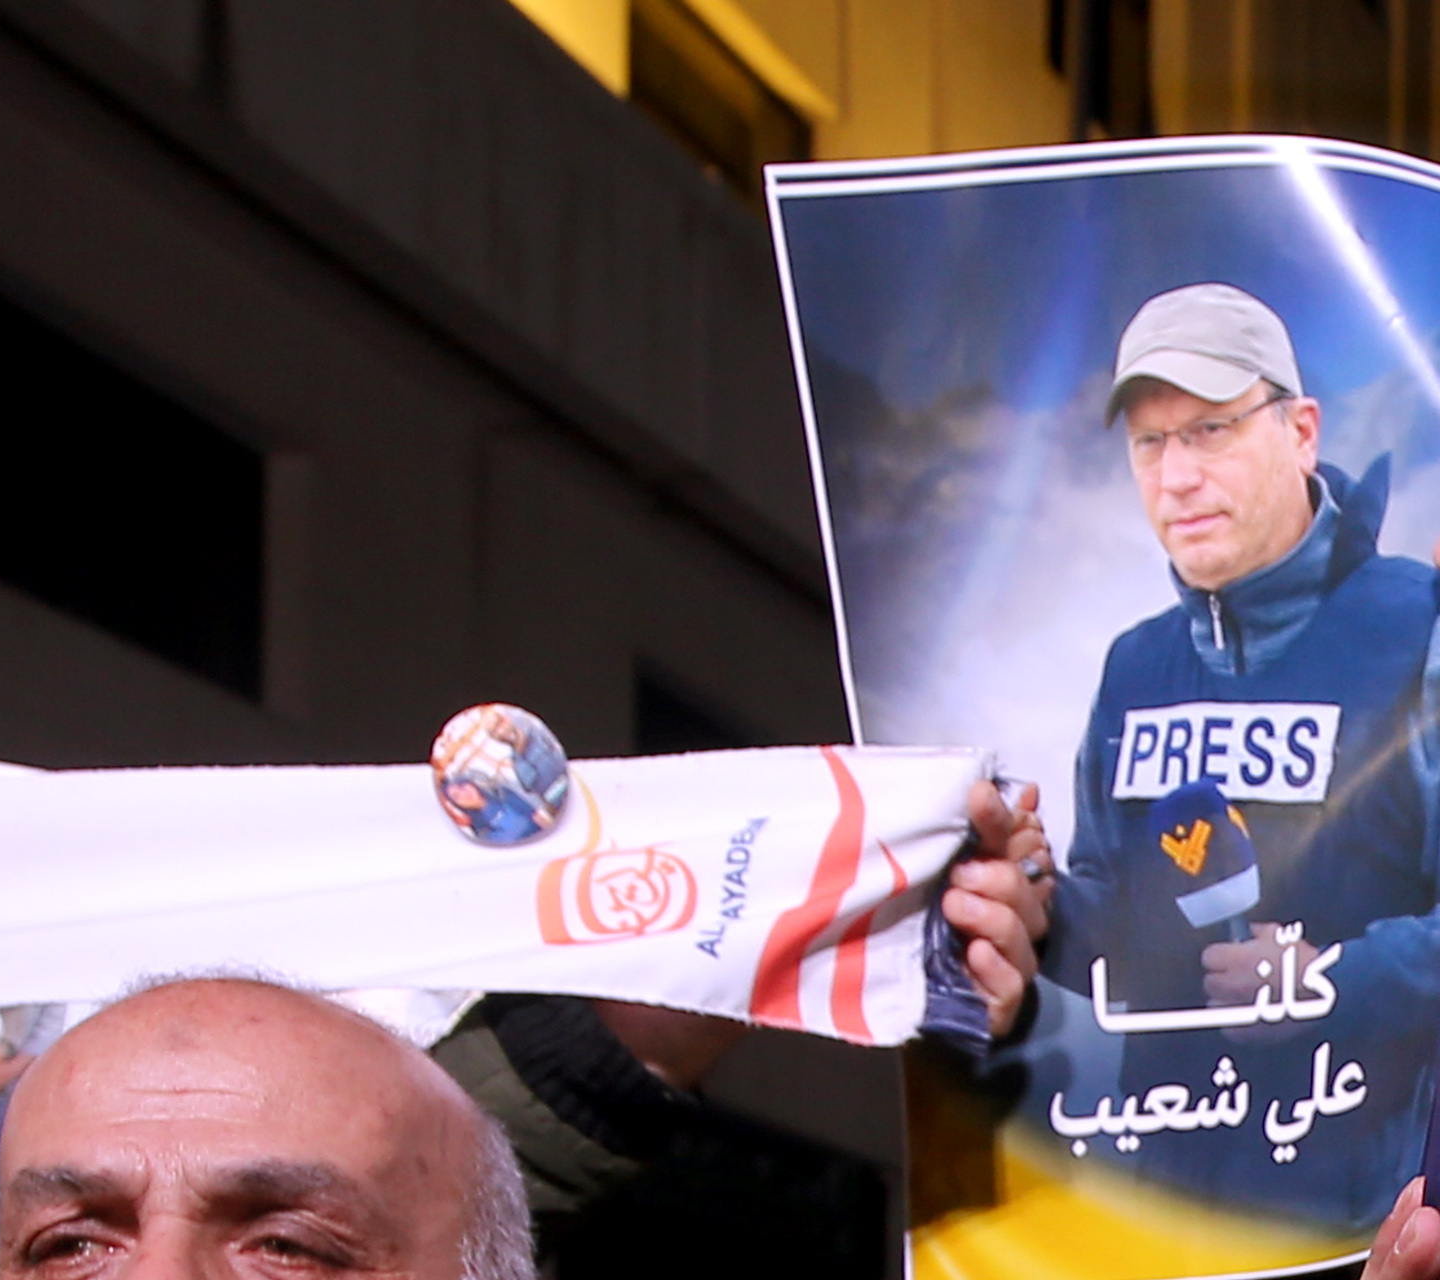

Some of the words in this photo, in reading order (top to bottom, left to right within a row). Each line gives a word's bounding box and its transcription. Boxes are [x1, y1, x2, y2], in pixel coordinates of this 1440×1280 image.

[1125, 715, 1320, 788] PRESS
[1049, 1056, 1250, 1158] شعيب
[1263, 1041, 1368, 1163] علي
